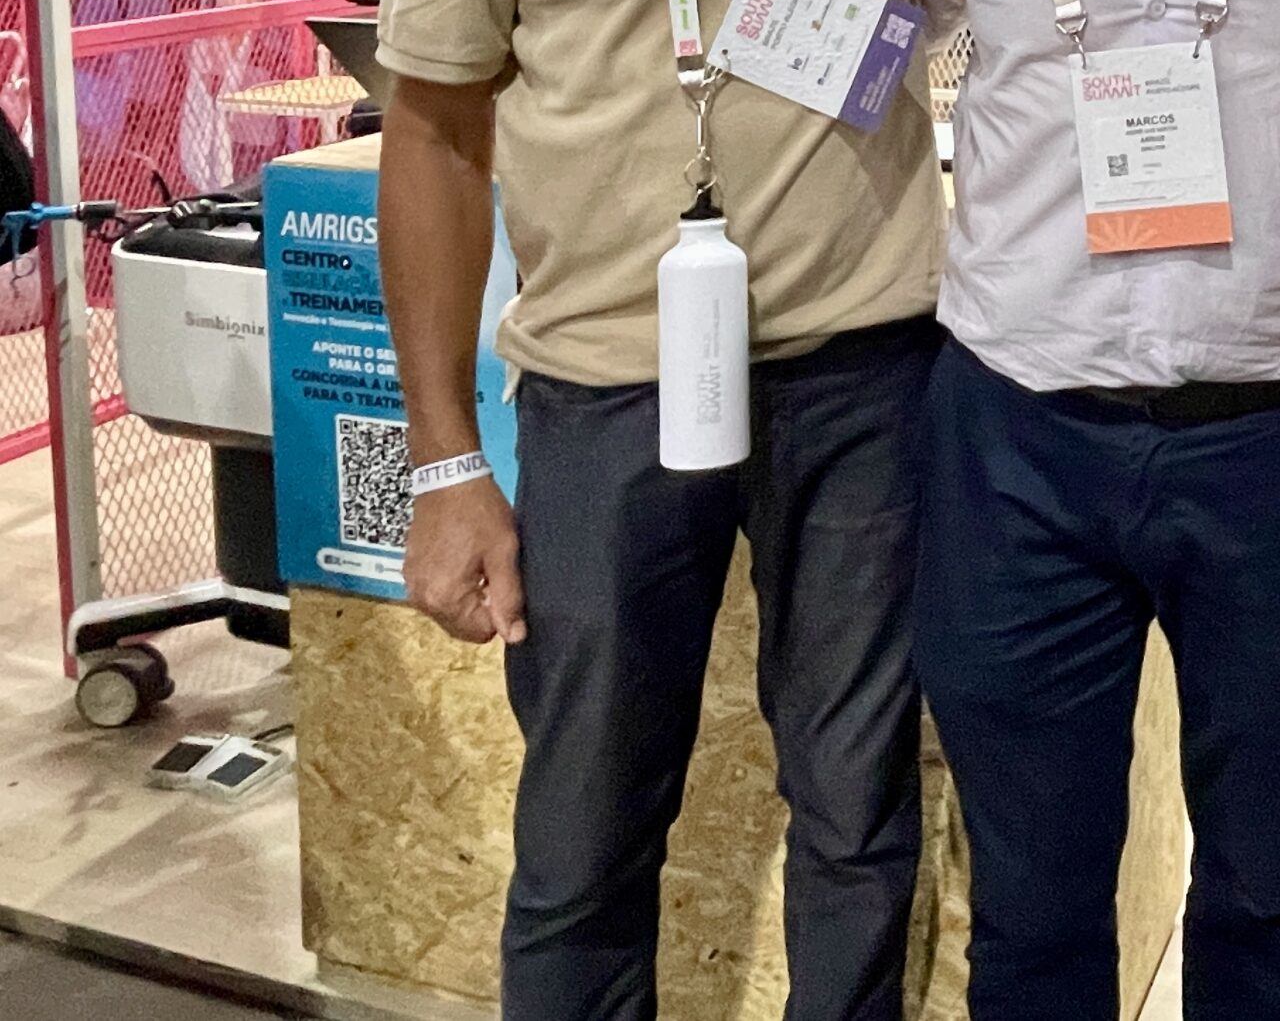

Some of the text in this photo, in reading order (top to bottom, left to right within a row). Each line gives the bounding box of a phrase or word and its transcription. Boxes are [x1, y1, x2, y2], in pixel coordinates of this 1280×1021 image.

[1082, 73, 1132, 91] SOUTH
[1083, 84, 1141, 102] SUMMIT
[1125, 113, 1176, 128] MARCOS
[280, 210, 378, 244] AMRIGS
[282, 249, 353, 270] CENTRO
[312, 341, 361, 358] APONTE
[363, 346, 375, 359] O
[328, 357, 361, 373] PARA
[363, 361, 375, 374] O
[303, 386, 340, 403] PARA
[343, 391, 354, 404] O
